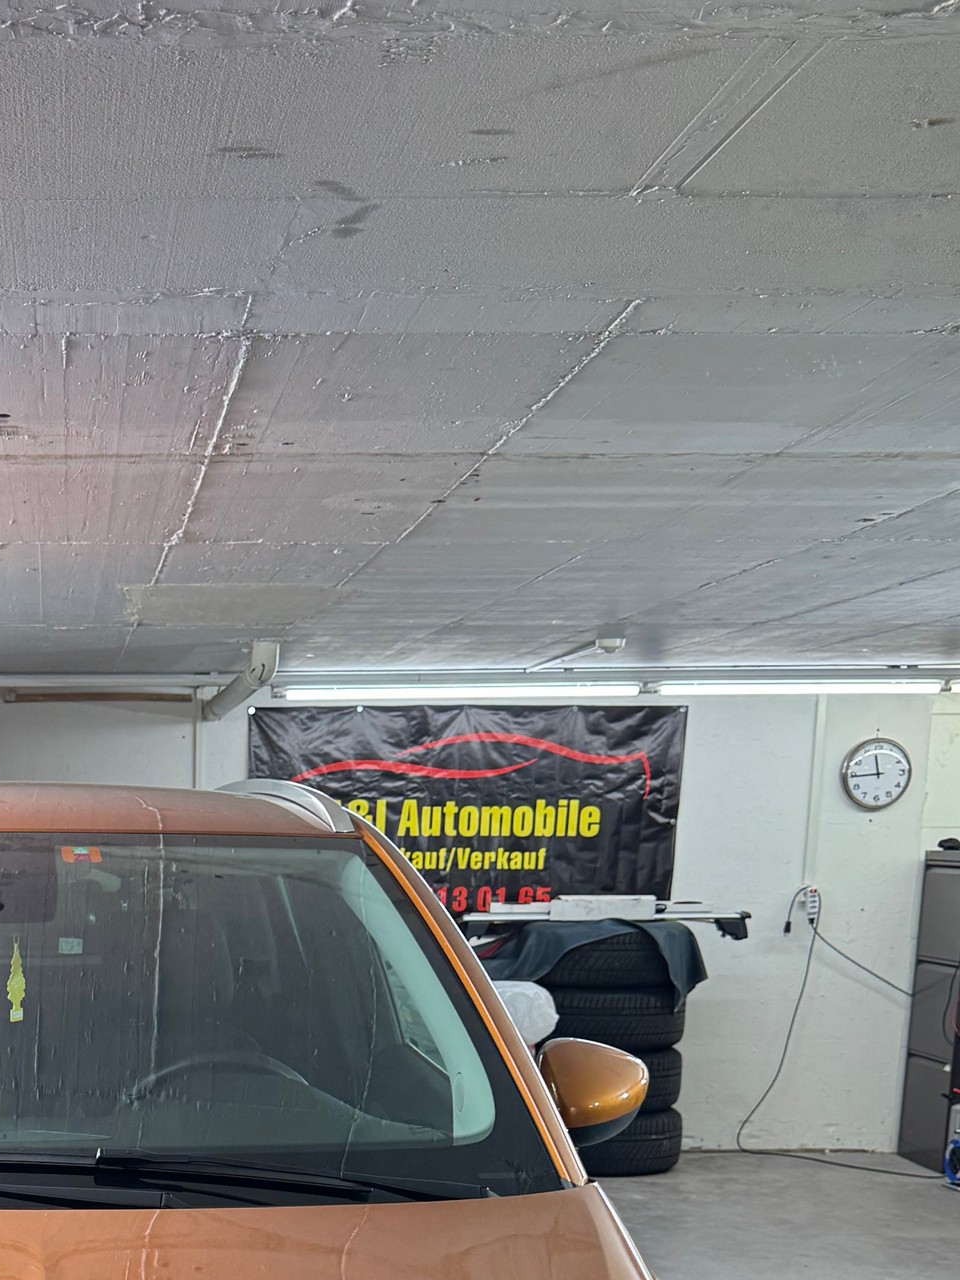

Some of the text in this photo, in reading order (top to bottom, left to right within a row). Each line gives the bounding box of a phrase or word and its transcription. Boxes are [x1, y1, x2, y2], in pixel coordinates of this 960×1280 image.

[336, 798, 601, 838] &I Automobile
[431, 886, 468, 913] 13
[476, 886, 506, 912] 01
